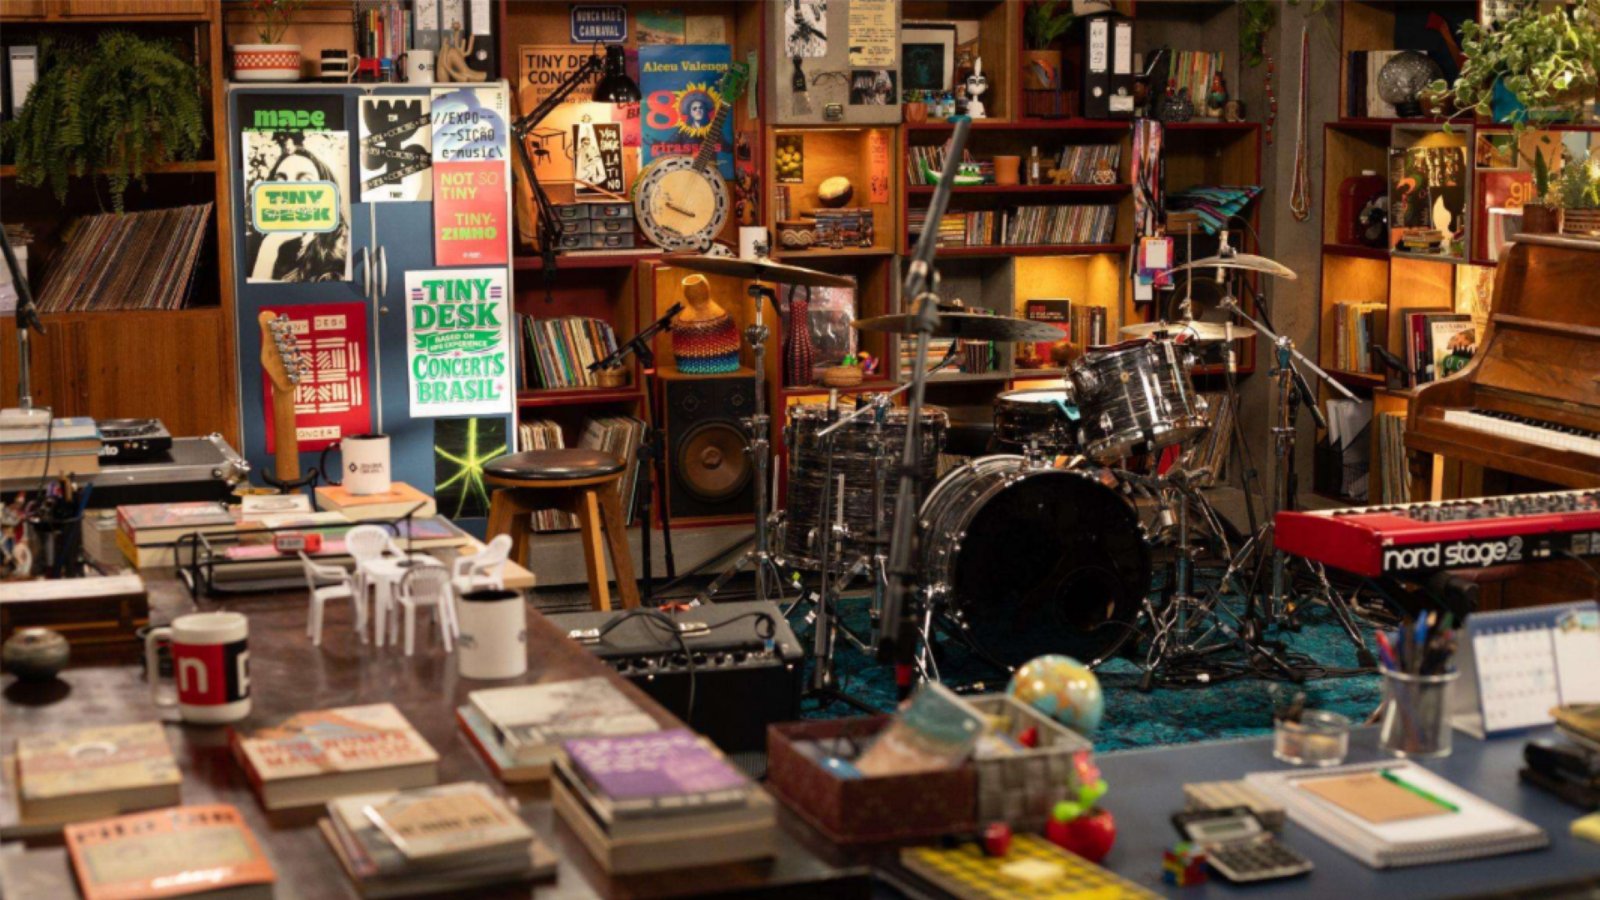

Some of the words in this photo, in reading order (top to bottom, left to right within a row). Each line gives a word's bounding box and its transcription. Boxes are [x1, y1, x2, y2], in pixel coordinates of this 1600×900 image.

[579, 25, 619, 36] CARNAVAL
[526, 54, 563, 68] TINY
[643, 62, 678, 73] Alceu
[441, 172, 474, 186] NOT
[479, 171, 499, 185] SO
[265, 190, 324, 204] TINY
[441, 186, 477, 200] TINY
[261, 207, 330, 222] DESK
[454, 211, 497, 226] TINY-
[441, 227, 497, 240] ZINHO
[422, 278, 492, 304] TINY
[412, 302, 502, 331] DESK
[434, 333, 461, 344] BASED
[463, 332, 475, 340] ON
[412, 352, 505, 380] CONCERTS
[416, 379, 500, 404] BRASIL
[1383, 543, 1440, 571] nord
